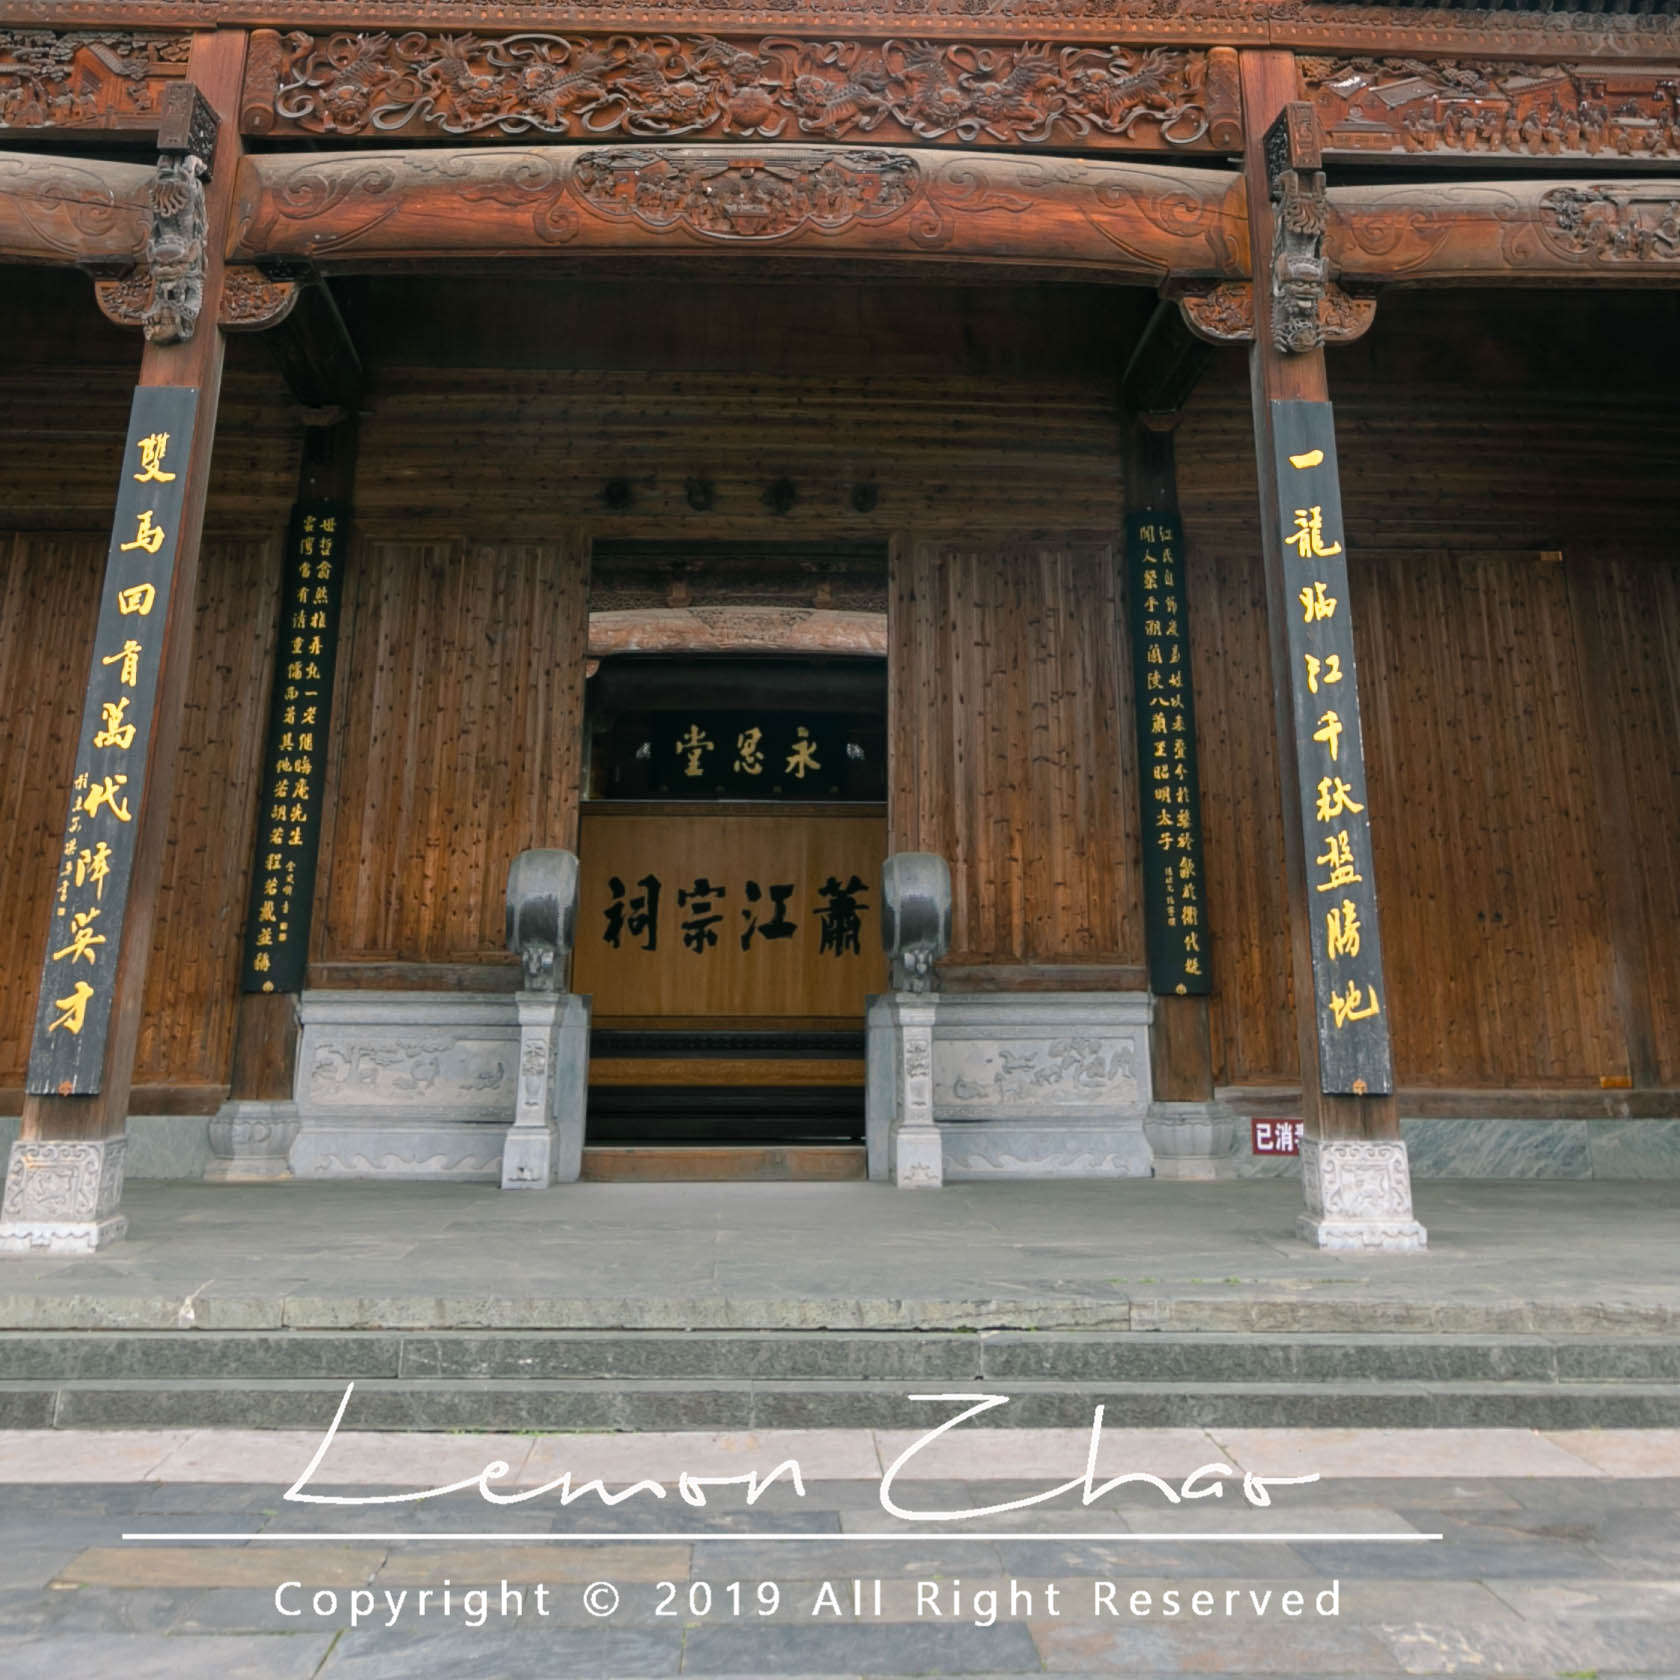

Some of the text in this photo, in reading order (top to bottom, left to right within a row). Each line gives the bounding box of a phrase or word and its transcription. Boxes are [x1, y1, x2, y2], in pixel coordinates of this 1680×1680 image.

[676, 724, 821, 778] 永思堂
[602, 873, 871, 956] 蕭江宗祠
